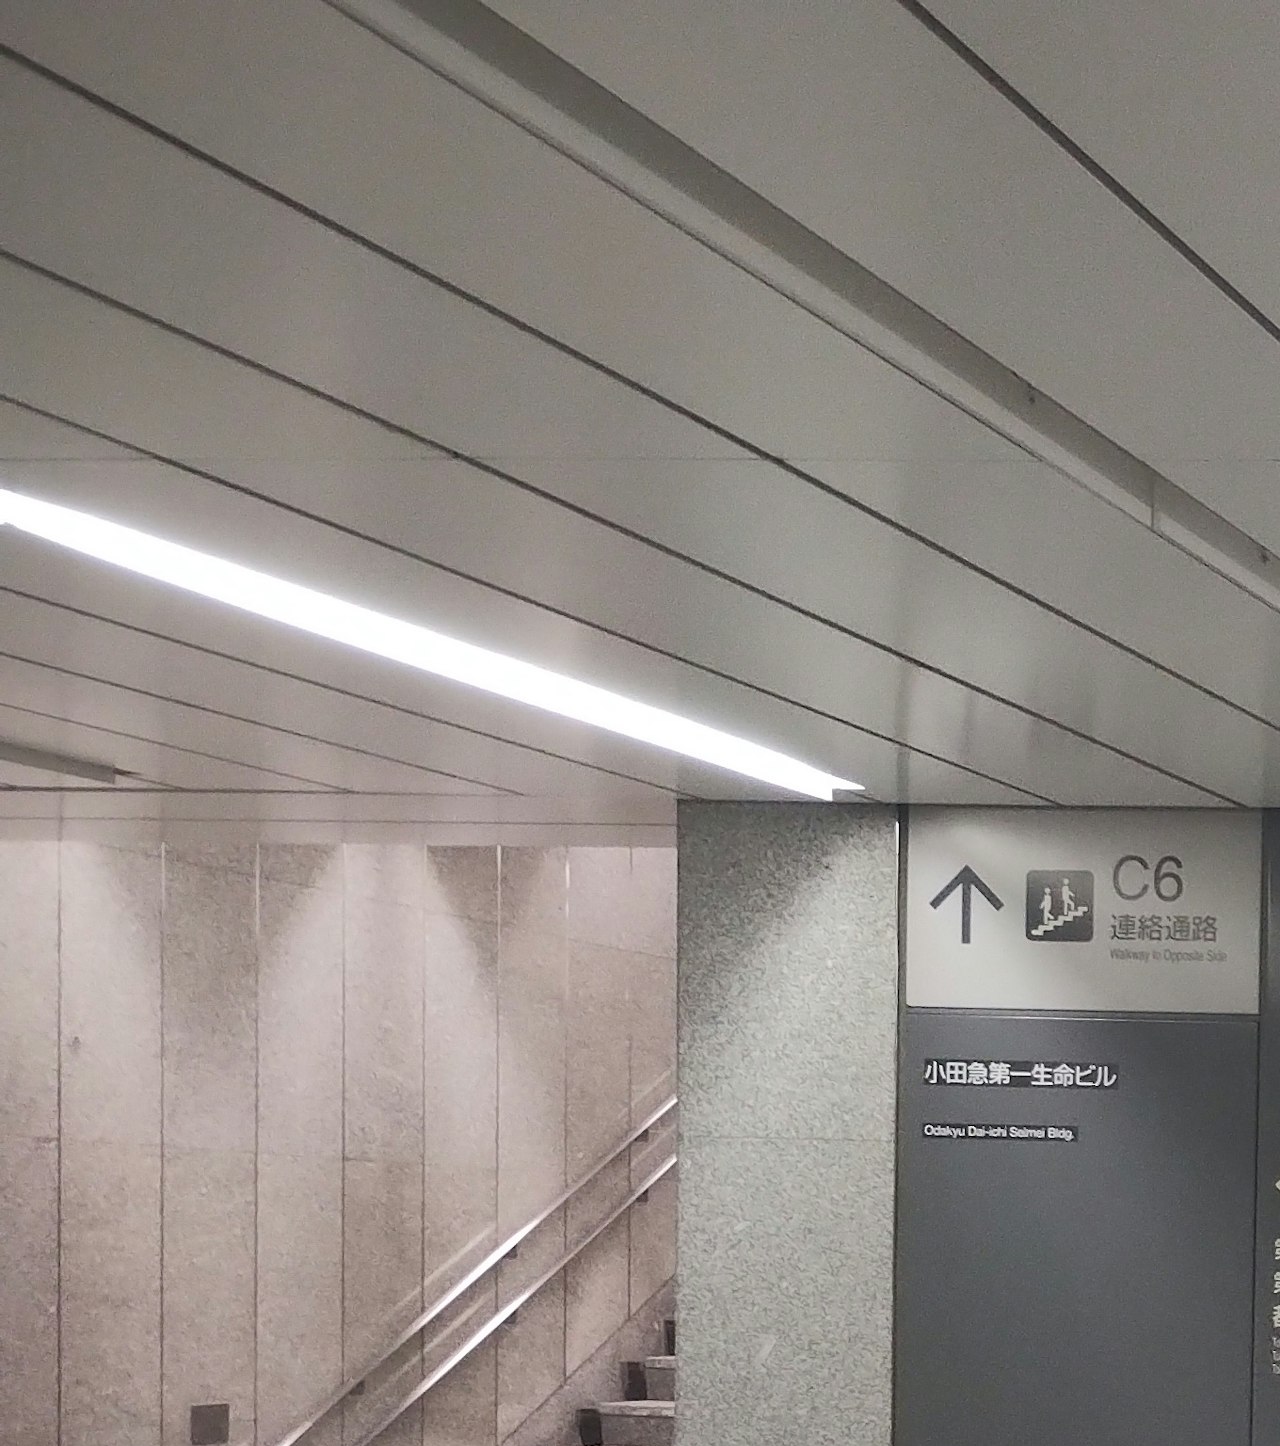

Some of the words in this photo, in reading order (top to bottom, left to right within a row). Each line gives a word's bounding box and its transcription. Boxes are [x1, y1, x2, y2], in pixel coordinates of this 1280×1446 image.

[1112, 853, 1183, 902] C6
[1110, 914, 1218, 943] 連絡通路
[924, 1061, 1117, 1088] 小田急第一生命ビル
[924, 1125, 966, 1139] Odakyu
[968, 1125, 1007, 1138] Dai-ichi
[1009, 1126, 1046, 1140] Seimei
[1048, 1127, 1074, 1141] Bldg.
